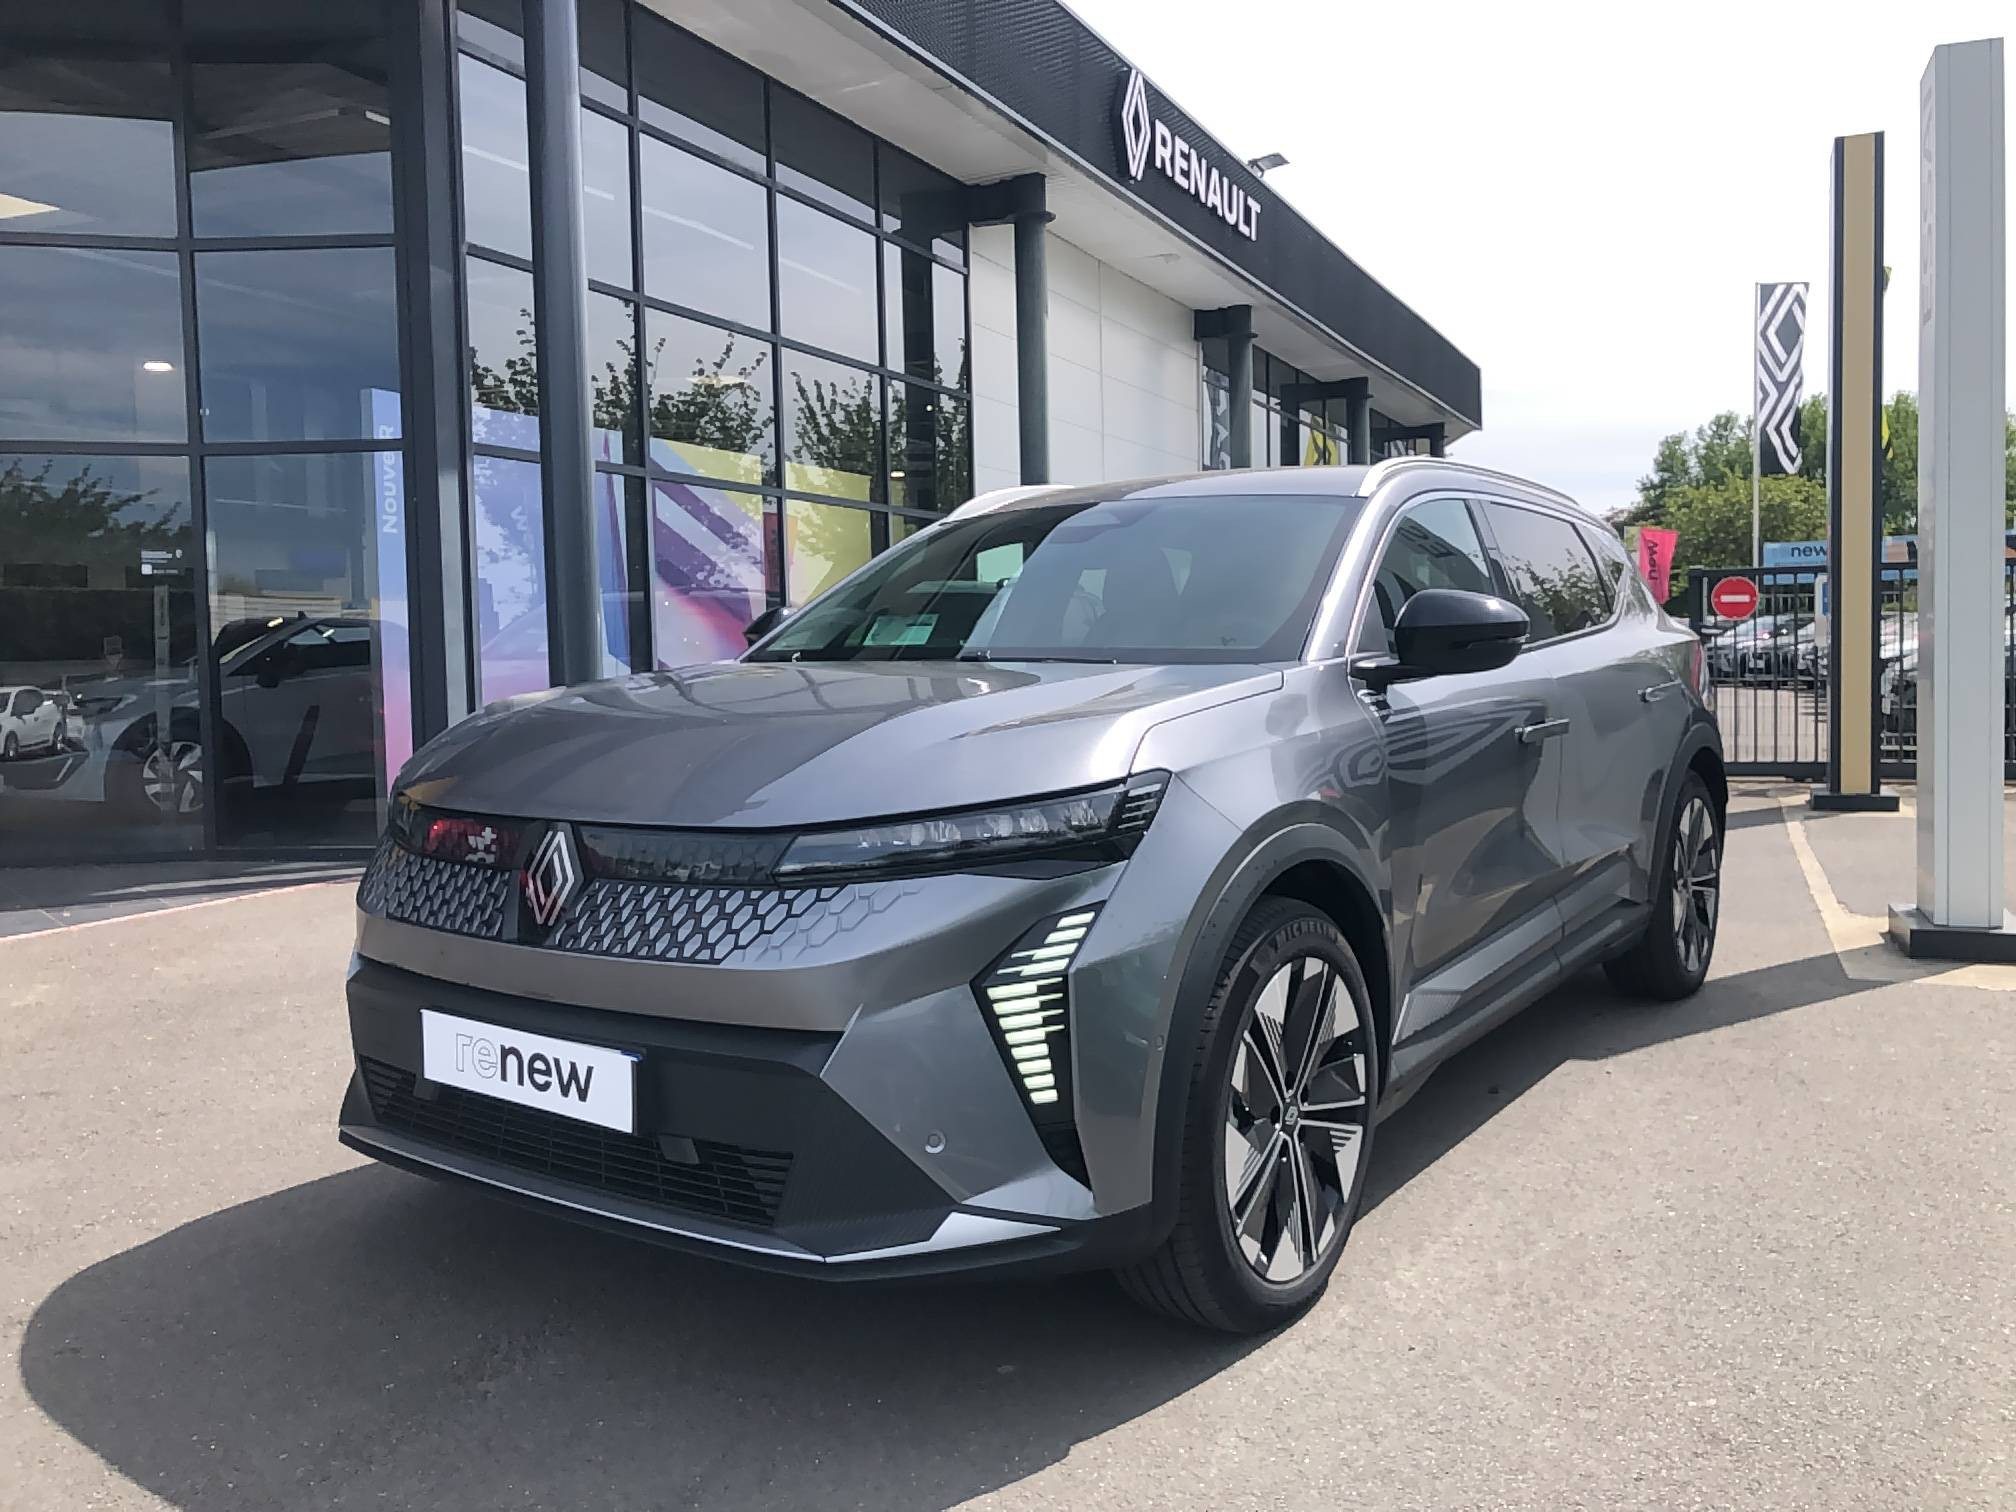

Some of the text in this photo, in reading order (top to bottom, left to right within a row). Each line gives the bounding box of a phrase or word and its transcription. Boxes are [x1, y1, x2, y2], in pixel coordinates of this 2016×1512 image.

[1155, 118, 1261, 242] RENAULT
[382, 451, 398, 534] Nouve
[1648, 540, 1658, 580] new
[1791, 545, 1827, 558] new
[456, 1033, 594, 1102] renew
